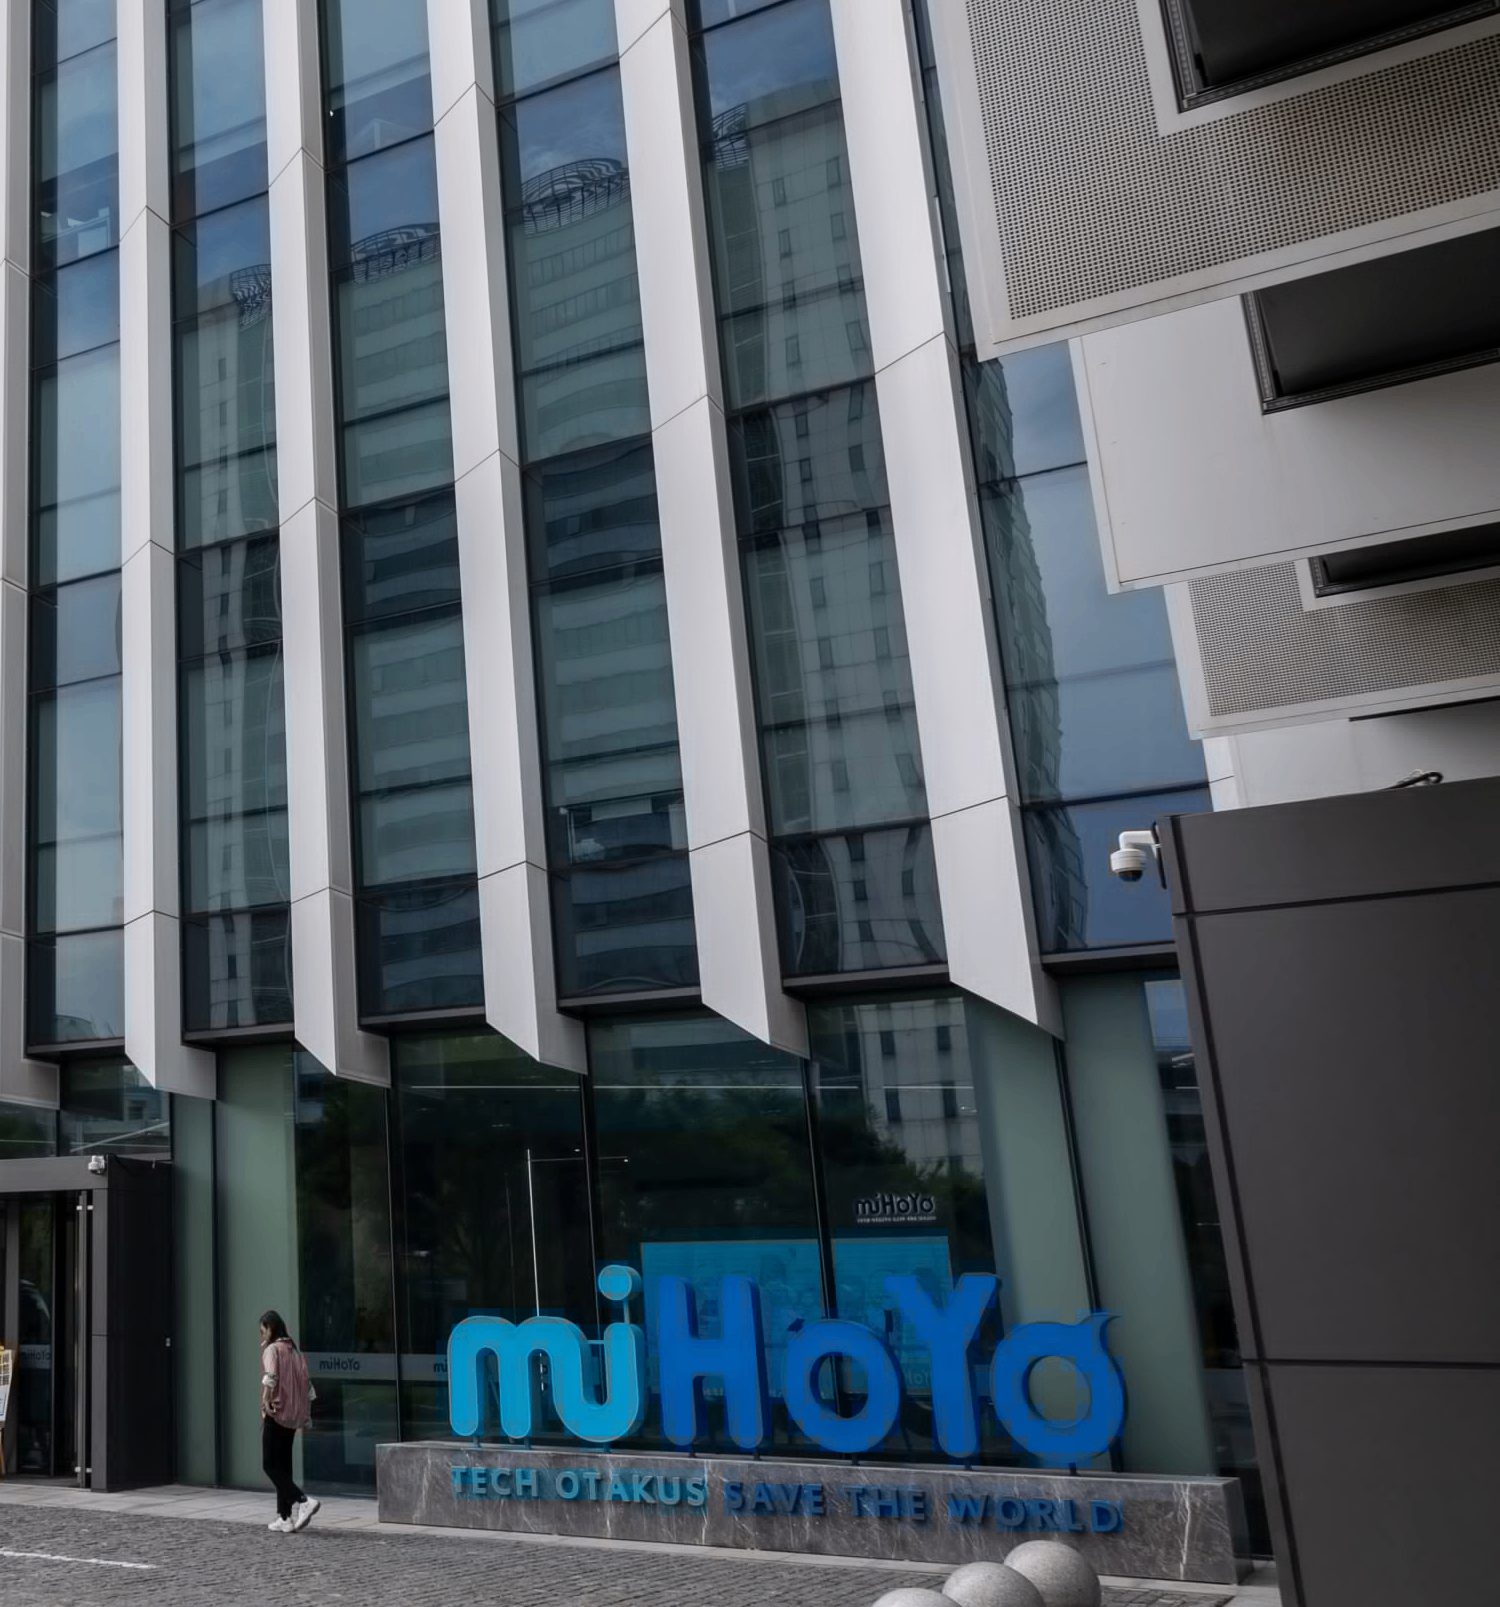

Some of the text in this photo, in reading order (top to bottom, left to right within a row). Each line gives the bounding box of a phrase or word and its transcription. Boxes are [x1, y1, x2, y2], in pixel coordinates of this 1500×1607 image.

[319, 1357, 361, 1371] miHoYo
[447, 1264, 1126, 1464] miHoYo
[451, 1467, 1122, 1533] TECH OTAKUS SAVE THE WORLD
